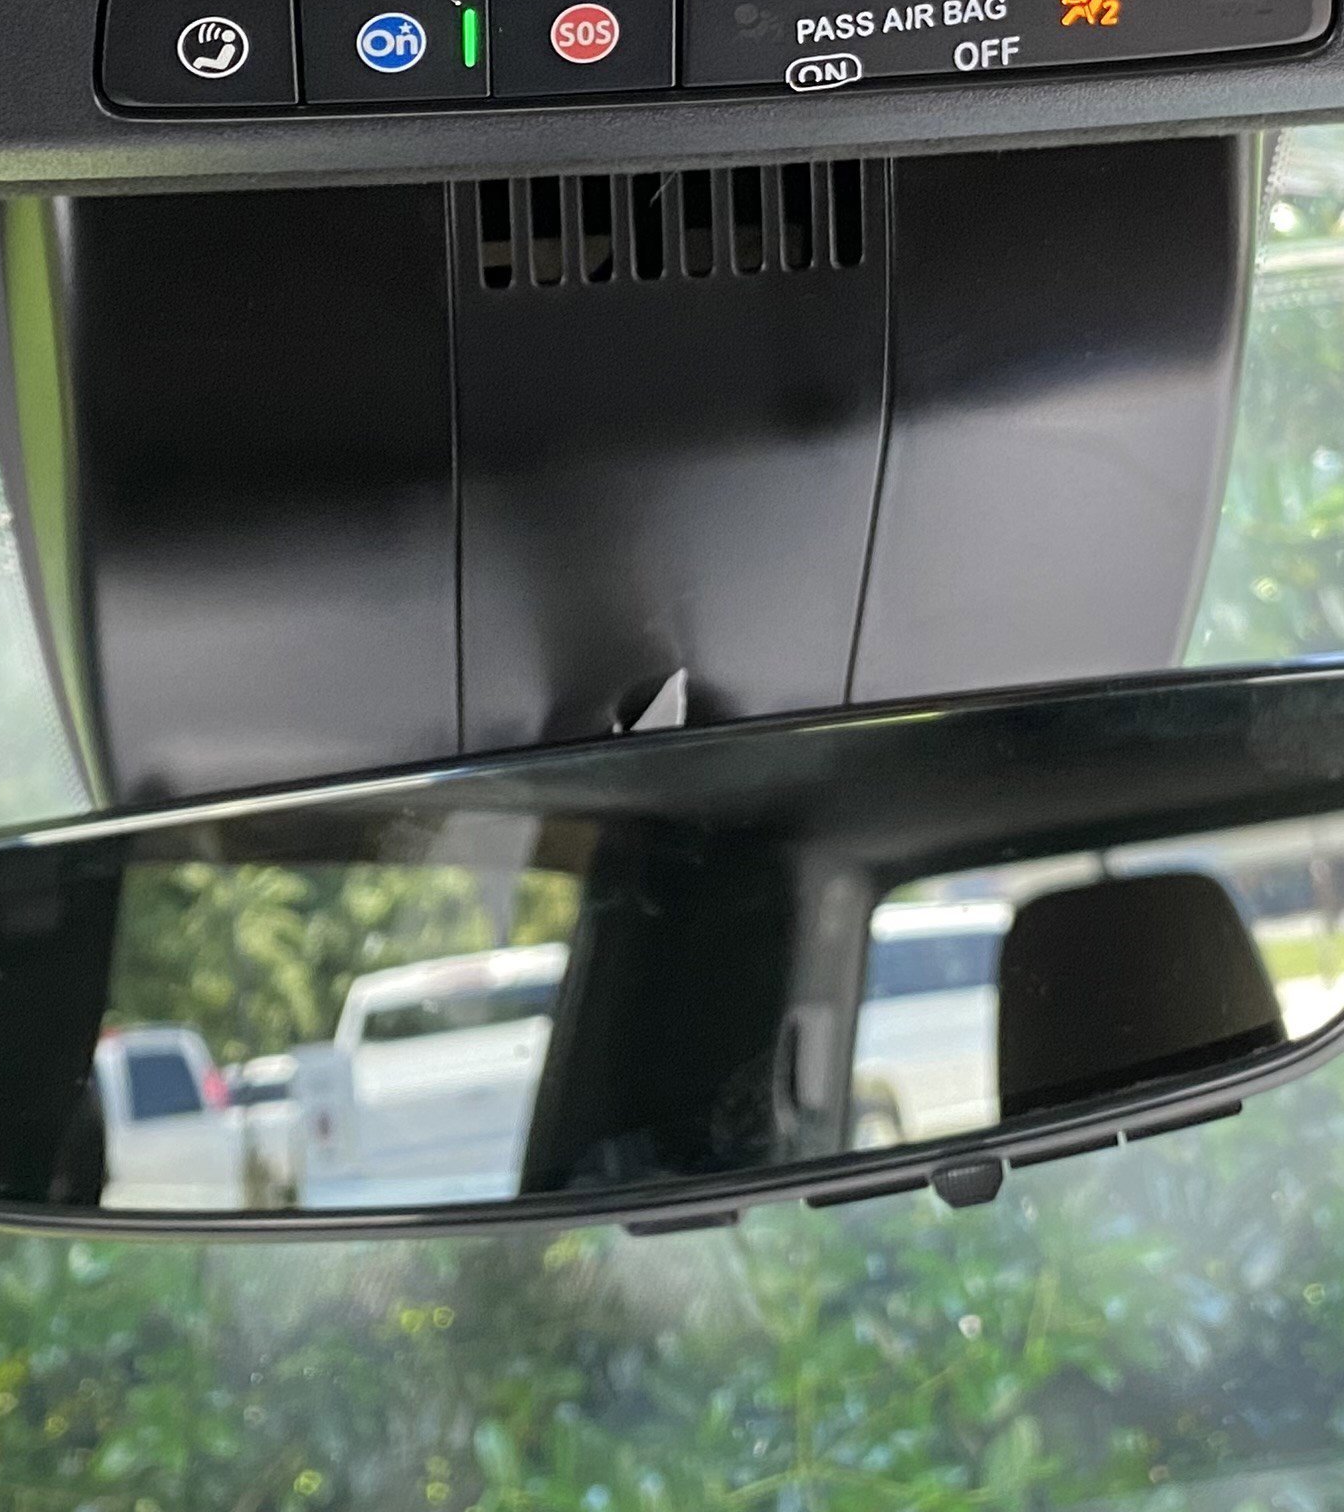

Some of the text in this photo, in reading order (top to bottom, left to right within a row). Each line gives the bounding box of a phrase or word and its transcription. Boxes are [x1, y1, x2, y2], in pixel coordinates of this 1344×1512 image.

[558, 19, 612, 48] SOS
[796, 11, 875, 44] PASS
[882, 3, 935, 34] AIR
[953, 36, 1021, 72] OFF
